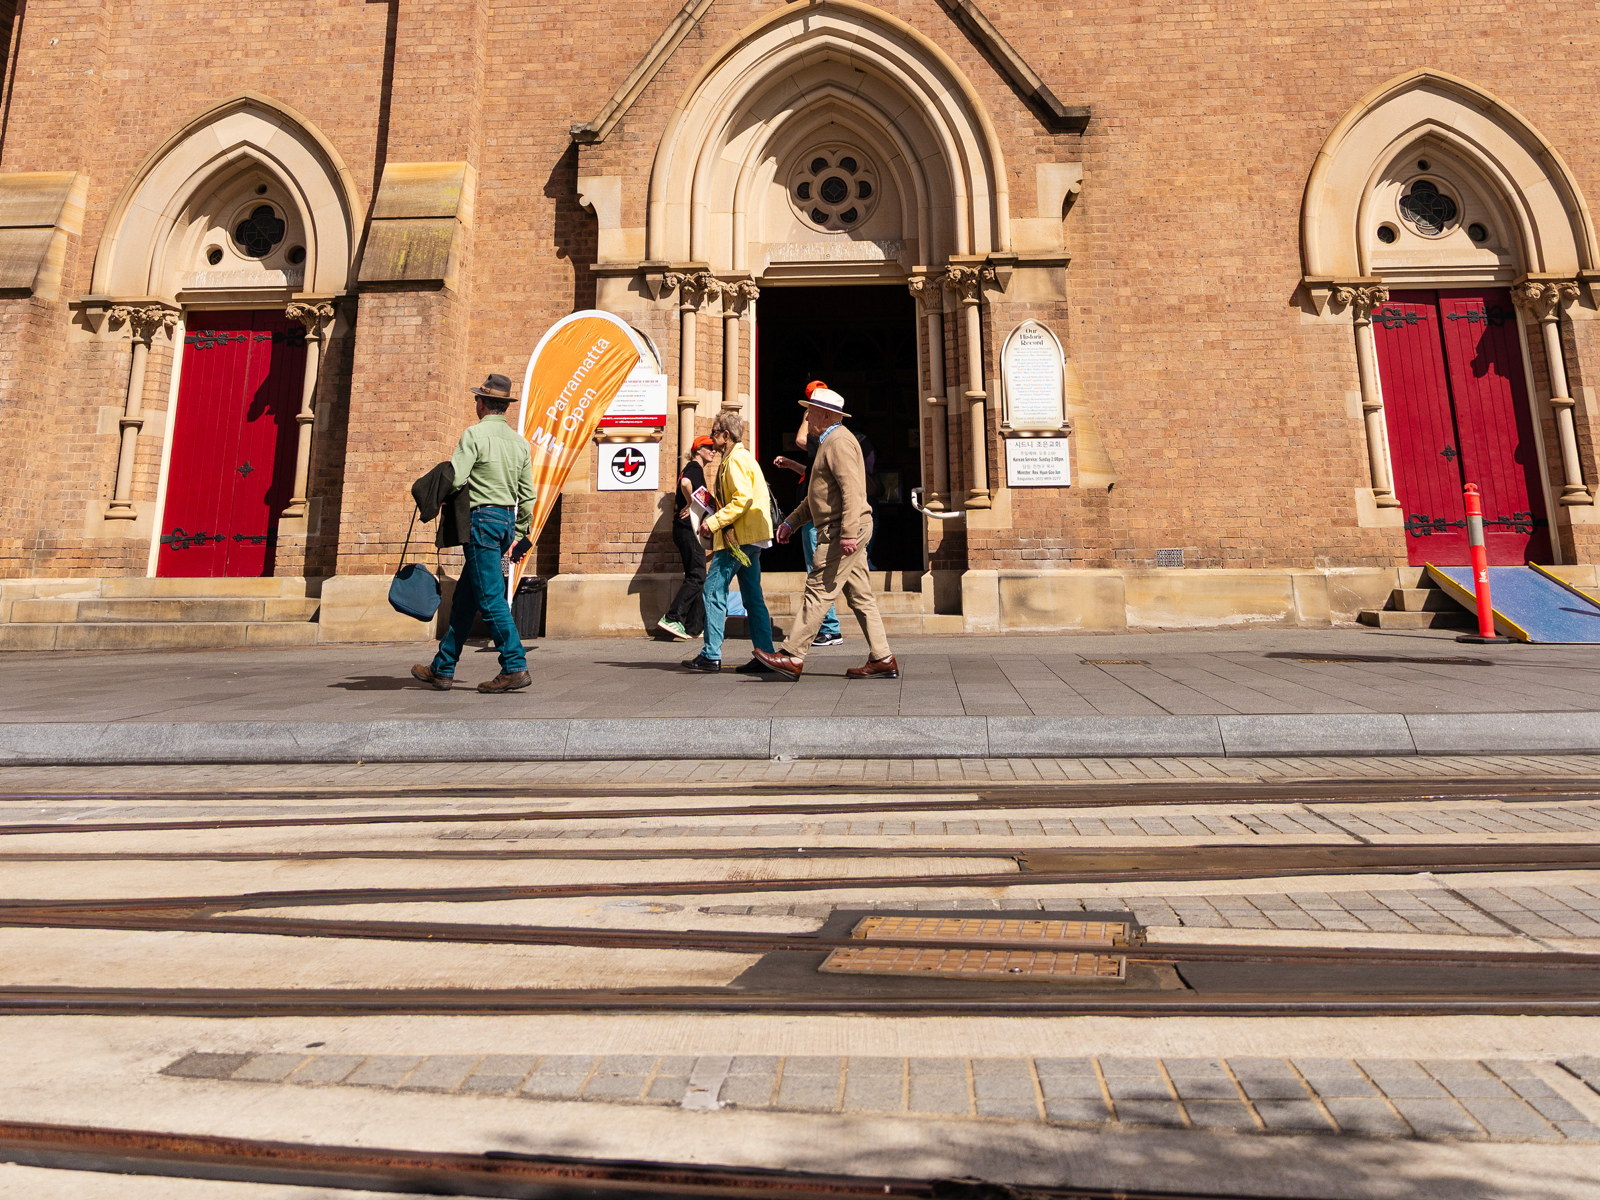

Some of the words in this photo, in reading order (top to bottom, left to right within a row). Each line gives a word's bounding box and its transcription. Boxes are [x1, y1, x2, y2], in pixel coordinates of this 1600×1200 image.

[546, 337, 612, 421] Parramatta
[562, 387, 597, 432] Open
[531, 426, 565, 457] MH
